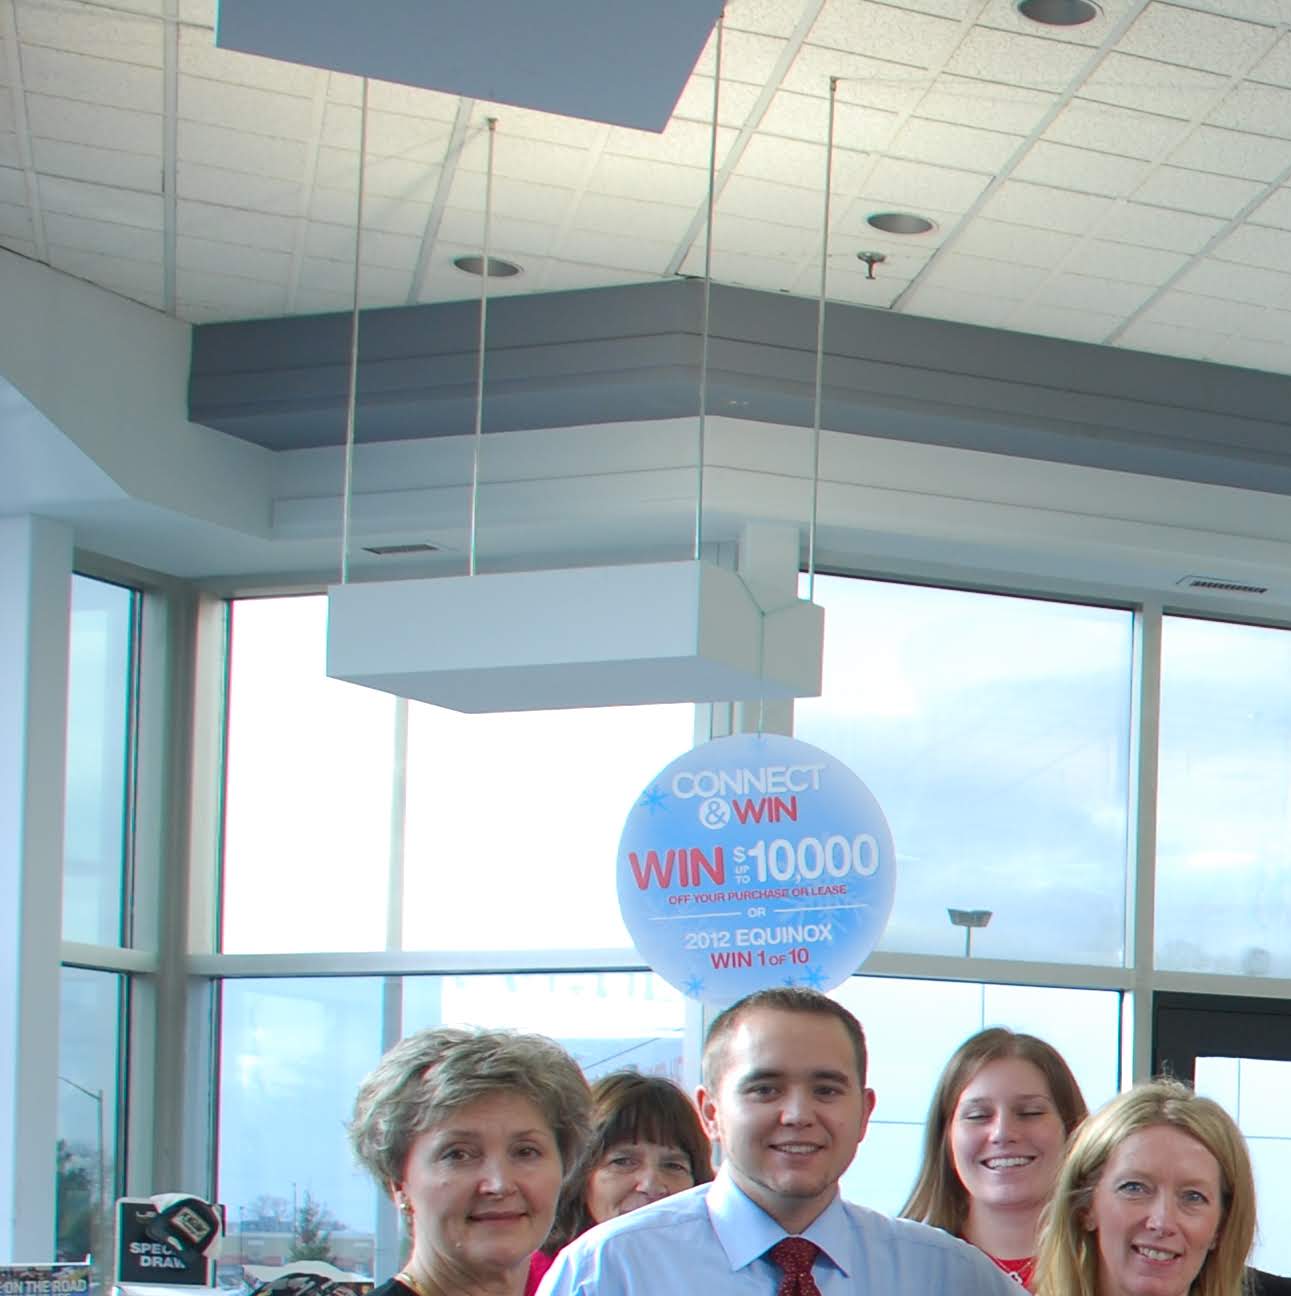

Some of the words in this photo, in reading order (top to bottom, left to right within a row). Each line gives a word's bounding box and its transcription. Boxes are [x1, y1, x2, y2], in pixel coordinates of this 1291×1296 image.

[672, 764, 826, 798] CONNECT
[702, 799, 730, 828] &
[732, 795, 798, 824] WIN
[628, 846, 725, 890] WIN
[733, 846, 745, 863] $
[748, 833, 880, 883] 10,000
[735, 866, 749, 875] UP
[735, 875, 751, 885] TO
[669, 895, 690, 905] OFF
[694, 892, 728, 904] YOUR
[728, 888, 789, 901] PURCHASE
[792, 887, 809, 897] OR
[811, 885, 847, 896] LEASE
[747, 907, 766, 918] OR
[685, 930, 731, 950] 2012
[736, 924, 833, 946] EQUINOX
[711, 951, 752, 969] WIN
[757, 950, 766, 967] 1
[769, 955, 786, 966] OF
[788, 948, 810, 966] 10
[5, 1280, 23, 1293] ON
[25, 1280, 50, 1293] THE
[52, 1279, 87, 1293] ROAD
